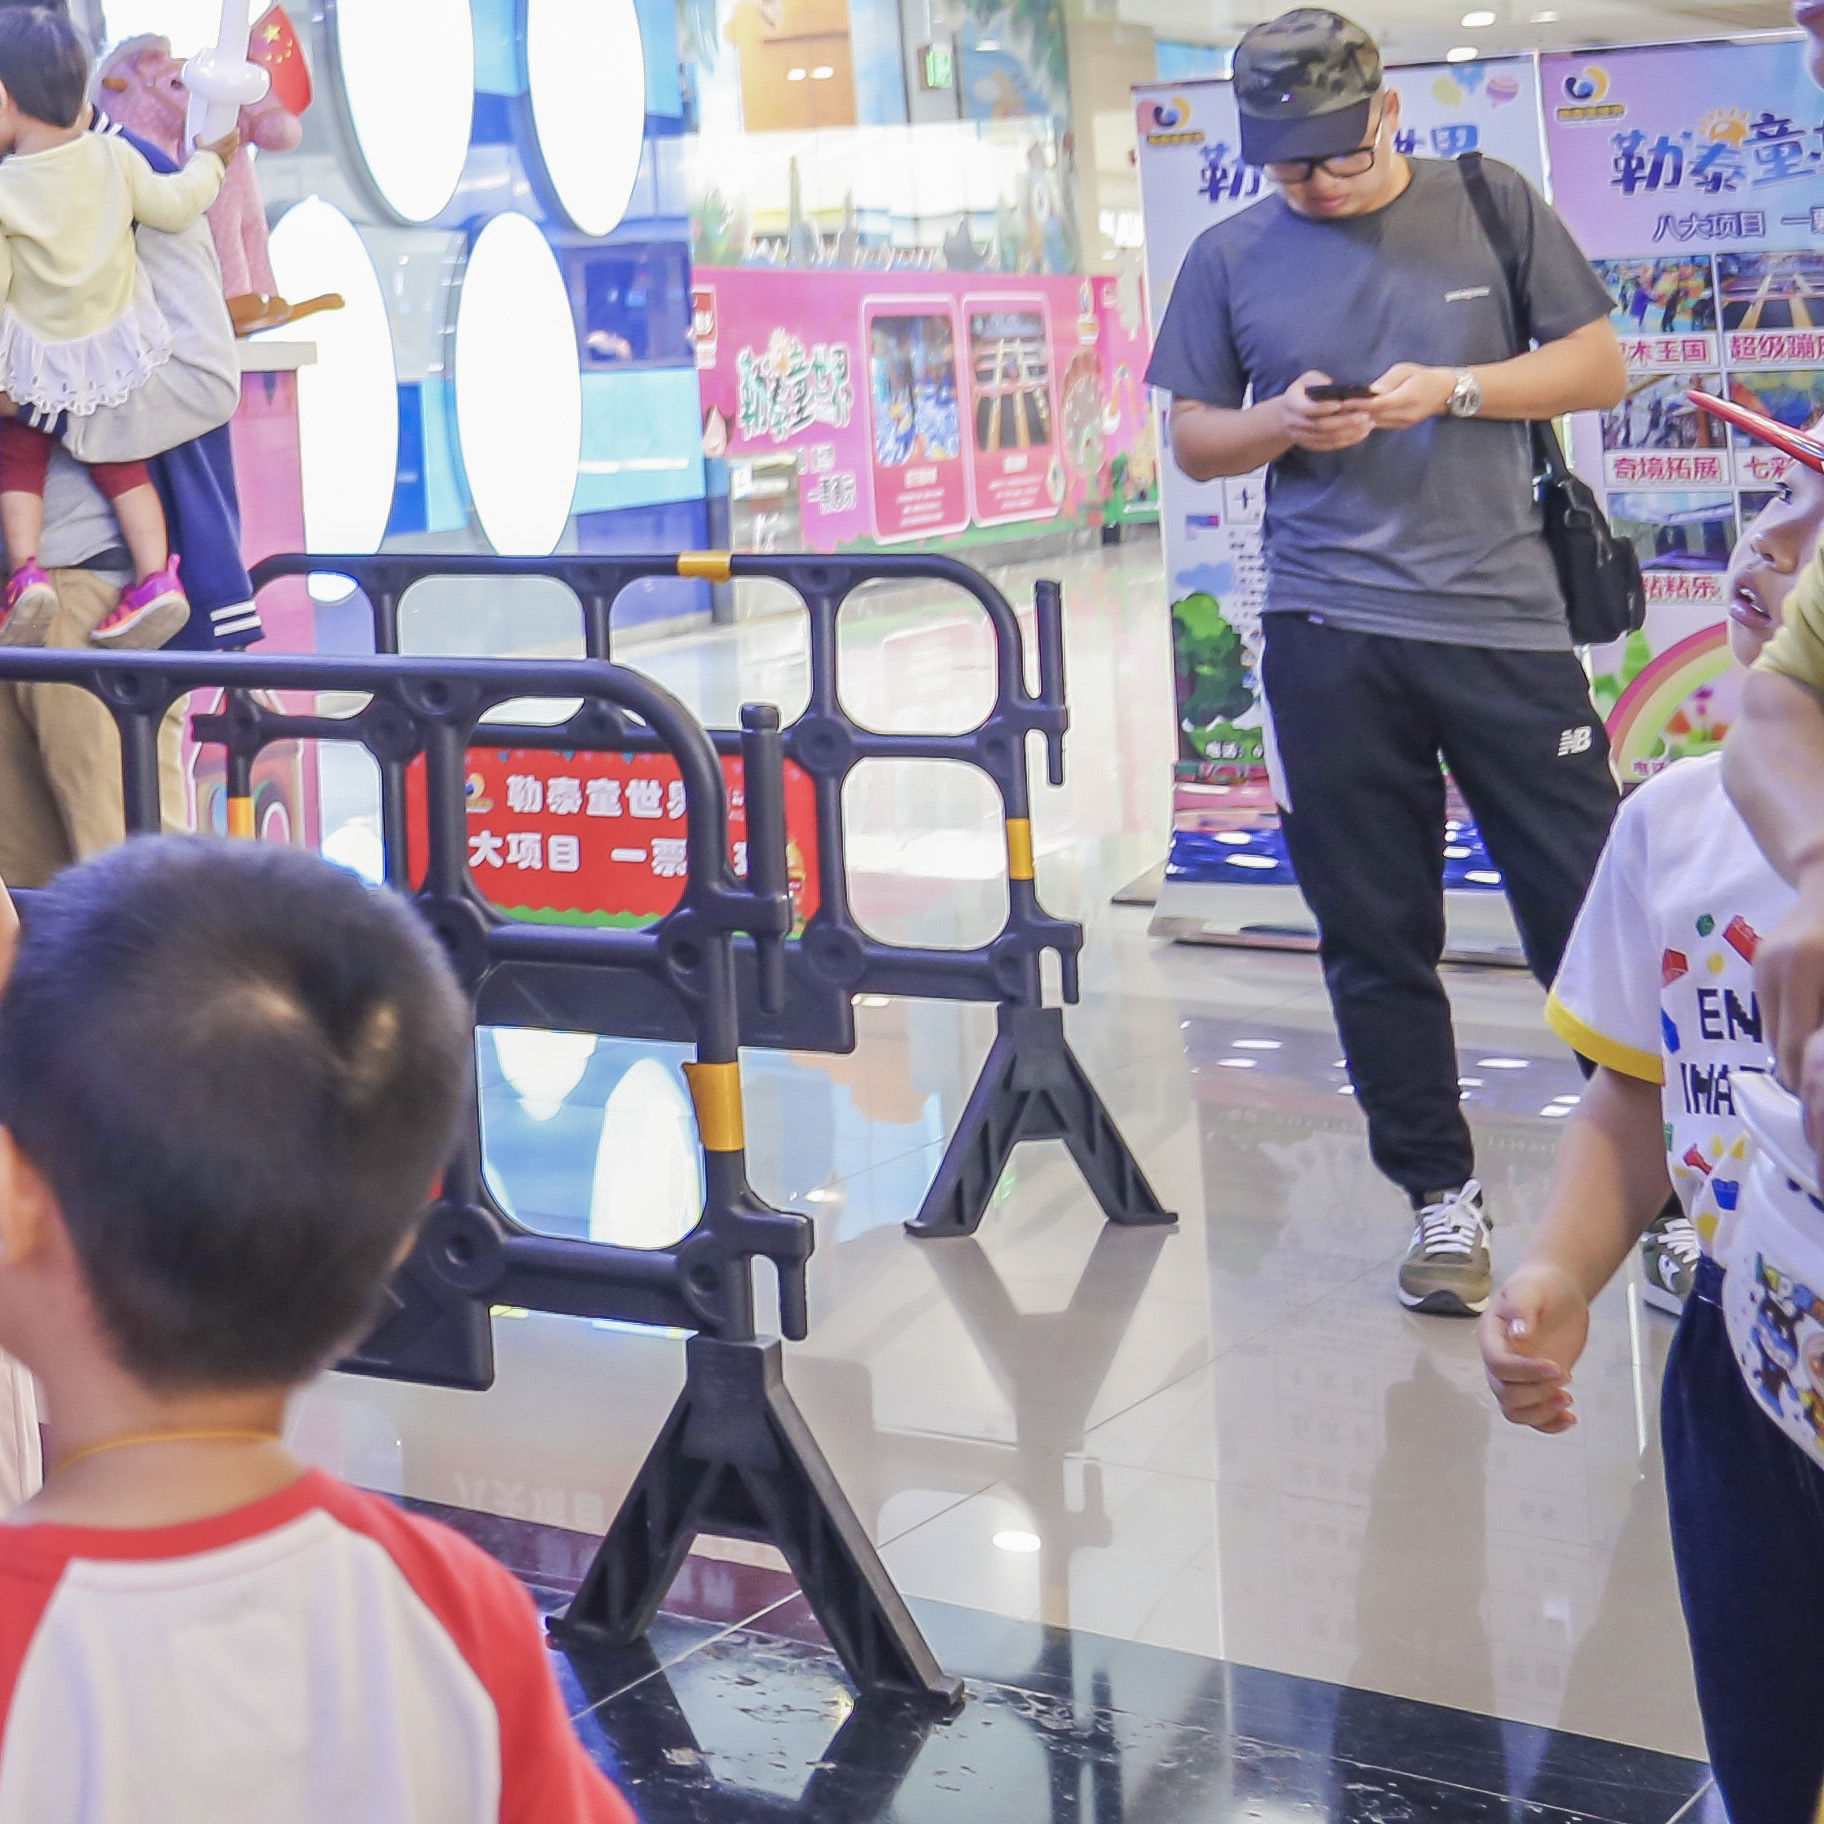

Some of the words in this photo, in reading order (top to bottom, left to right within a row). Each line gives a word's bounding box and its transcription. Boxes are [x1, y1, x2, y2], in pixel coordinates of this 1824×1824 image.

[1610, 112, 1824, 195] 勒泰童
[1621, 338, 1707, 363] 木王国
[1732, 334, 1824, 363] 超级蹦
